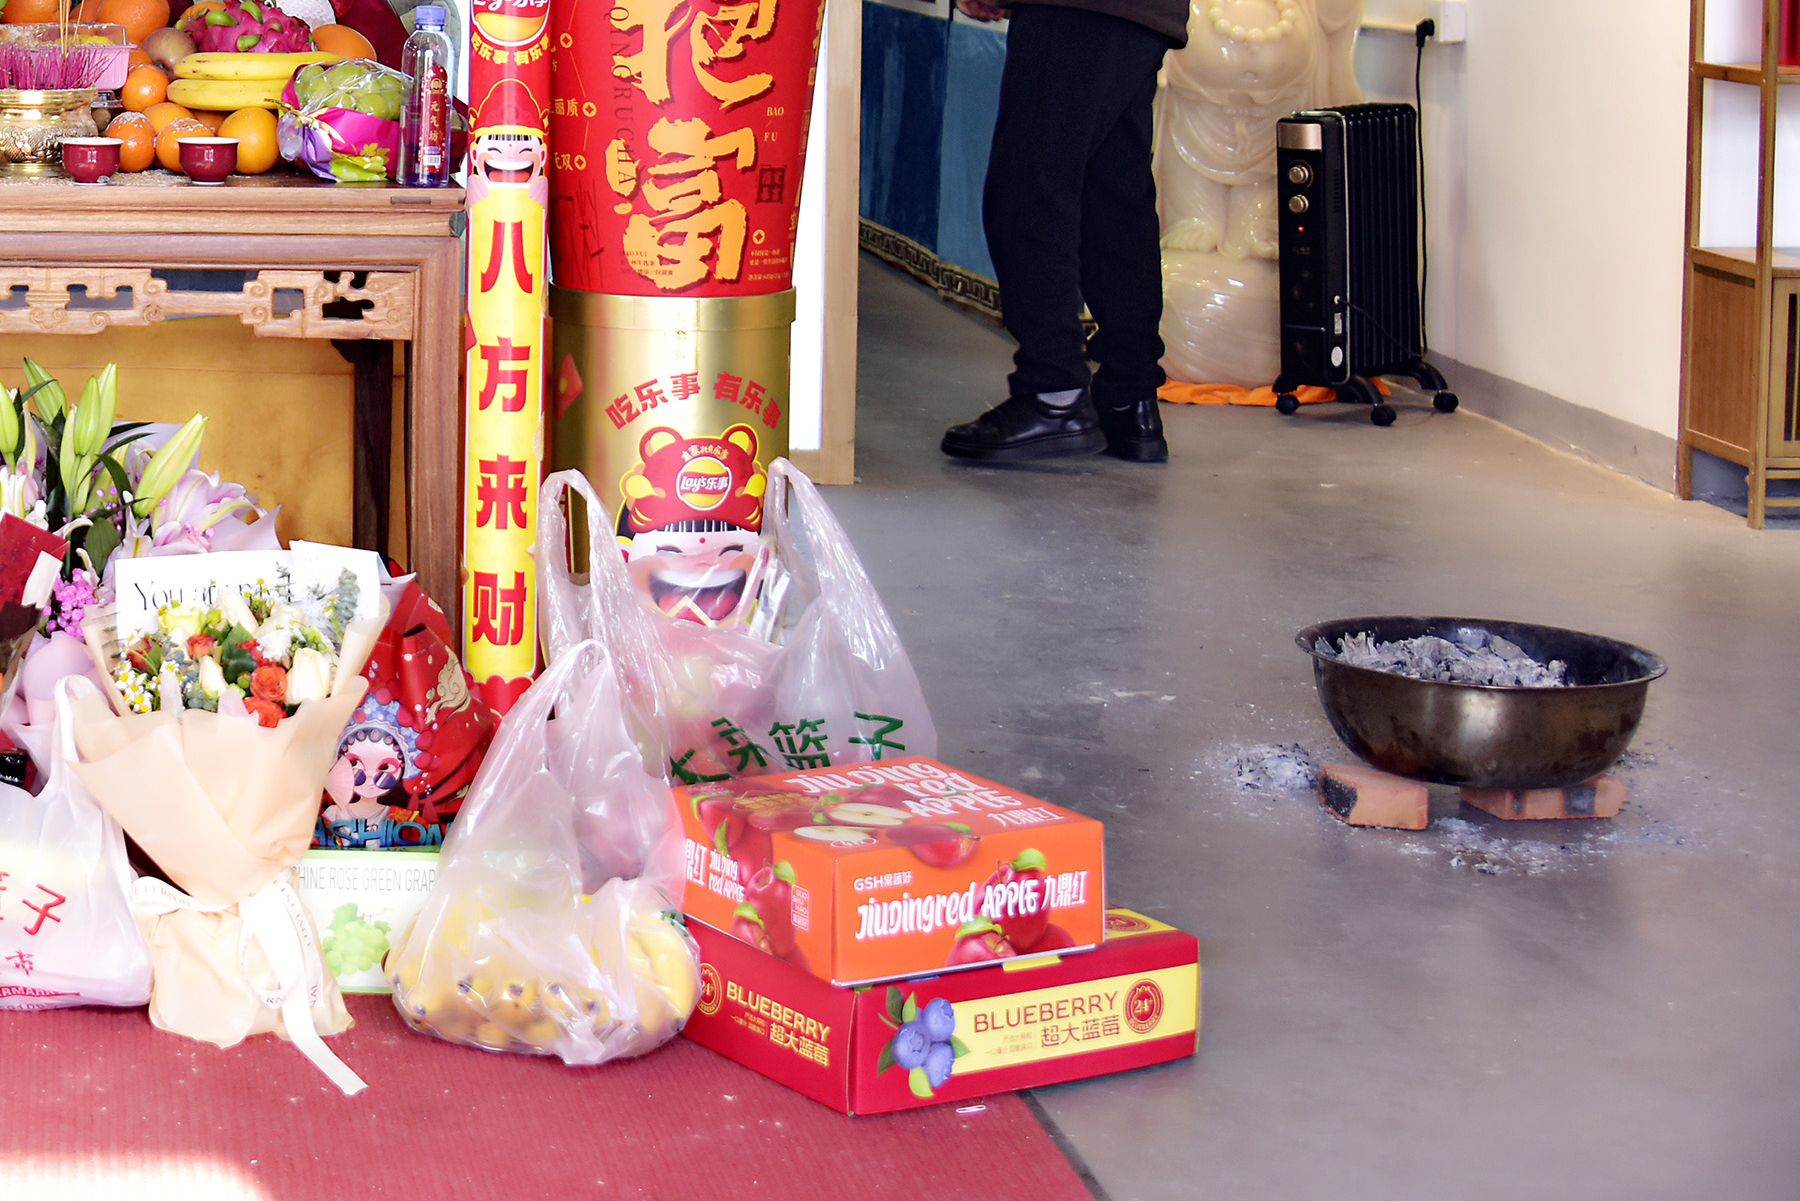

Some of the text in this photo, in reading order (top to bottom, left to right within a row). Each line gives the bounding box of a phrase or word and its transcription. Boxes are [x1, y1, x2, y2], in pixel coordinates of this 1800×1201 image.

[766, 106, 785, 117] BAO
[604, 371, 782, 430] 吃乐事 有乐事
[471, 219, 533, 647] 八方来财
[329, 867, 360, 891] ROSE
[362, 868, 402, 892] GREEN
[980, 878, 1039, 919] APPLE
[1041, 870, 1088, 910] 九鼎红
[726, 980, 832, 1042] BLUEBERRY
[973, 990, 1118, 1033] BLUEBERRY
[1040, 1013, 1121, 1048] 超大蓝莓
[769, 1021, 830, 1066] 超大蓝莓
